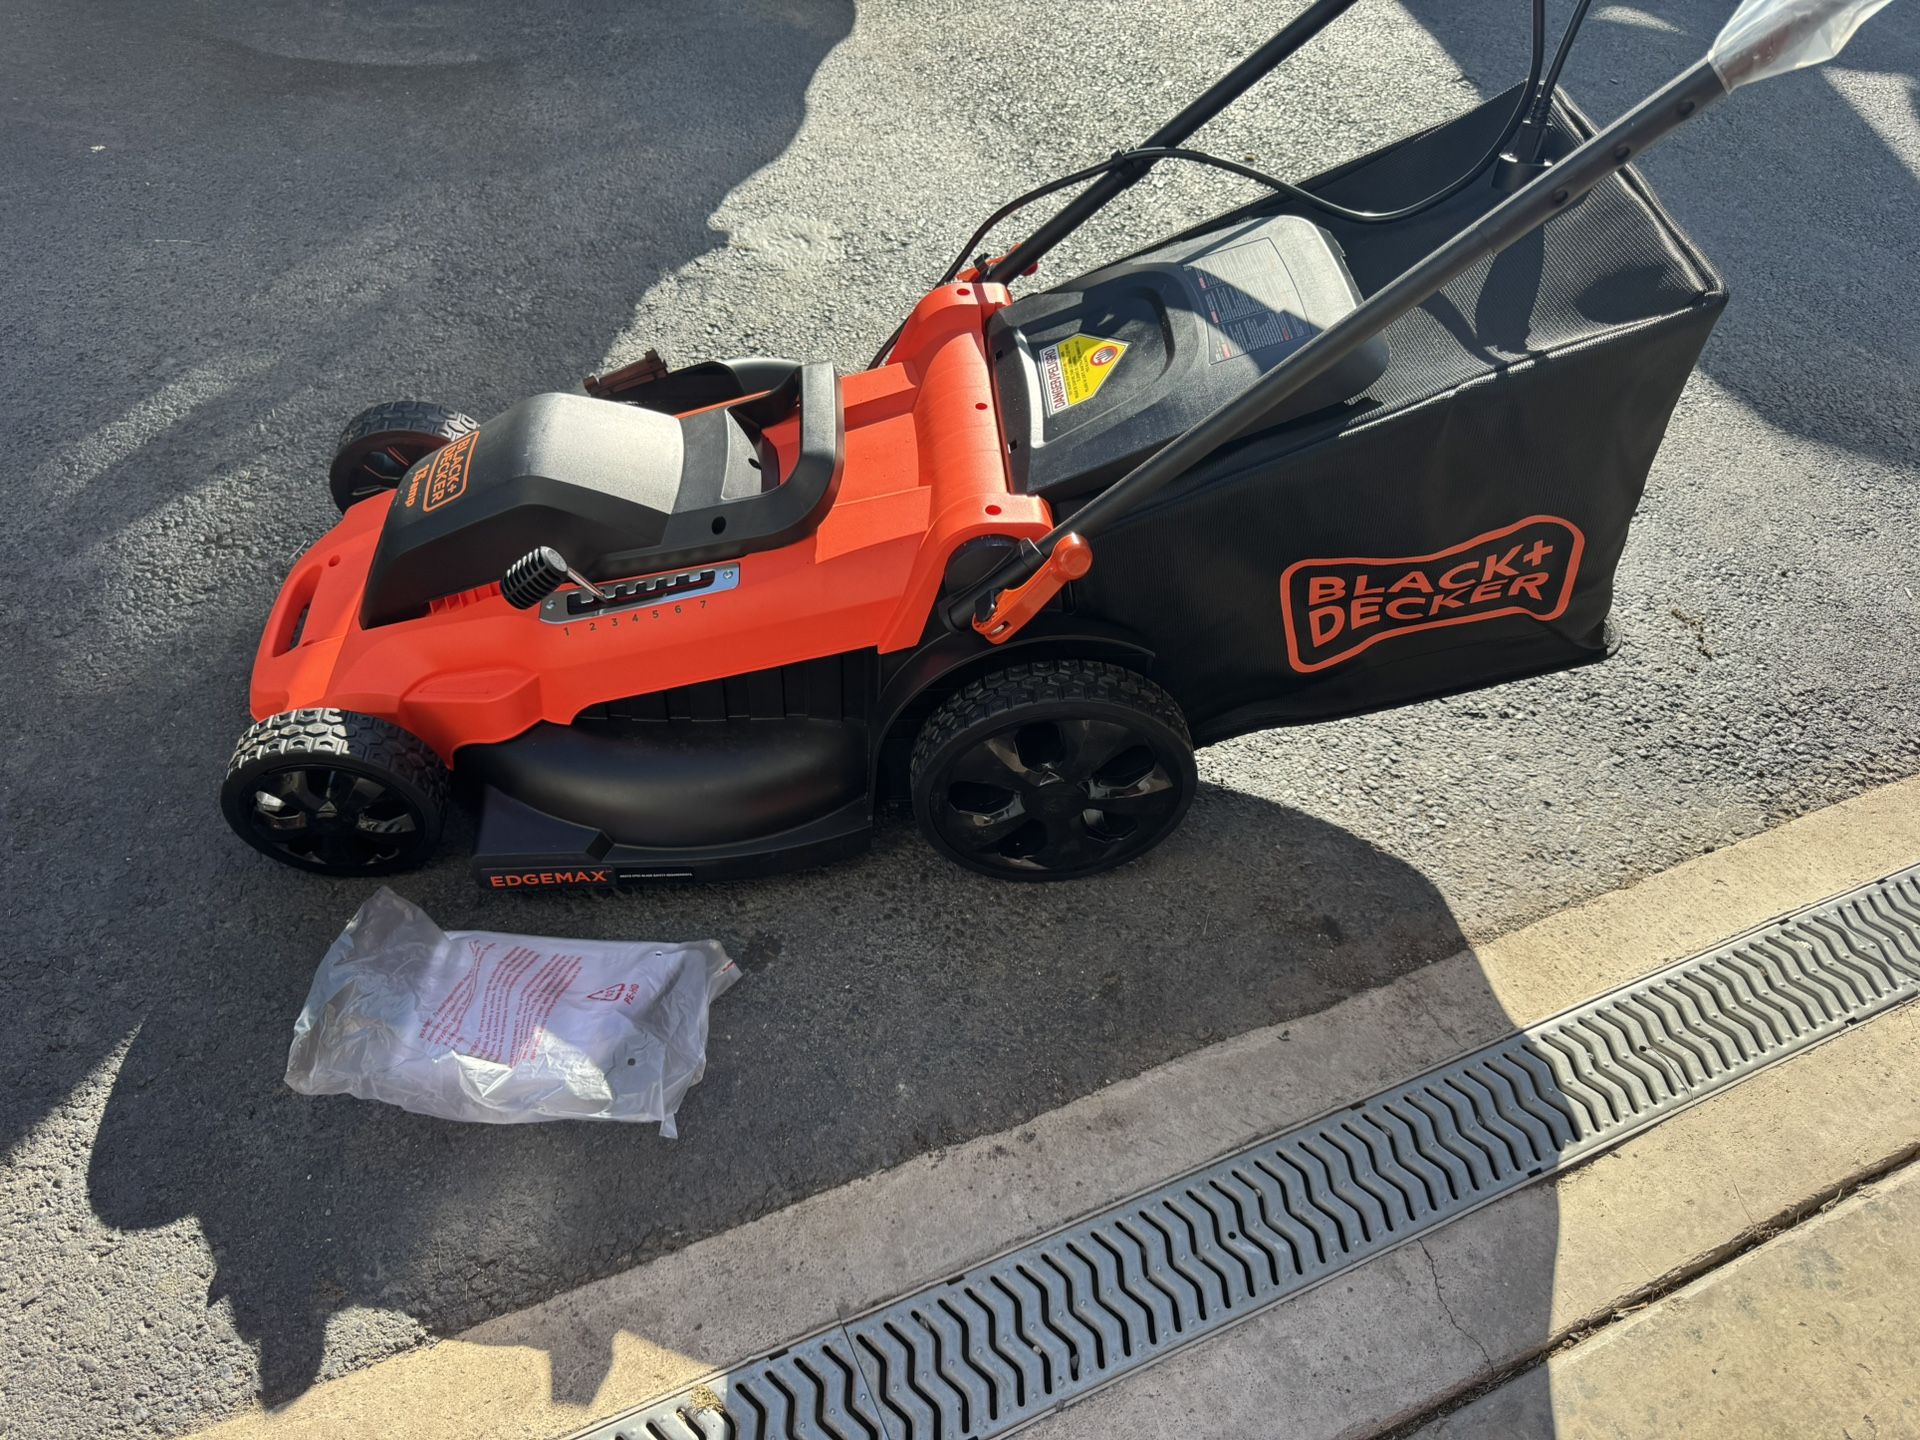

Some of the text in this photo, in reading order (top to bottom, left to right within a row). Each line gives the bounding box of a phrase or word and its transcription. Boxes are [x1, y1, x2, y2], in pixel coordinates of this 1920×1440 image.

[1045, 348, 1066, 409] DANGER/PELIGRO
[431, 445, 457, 503] DECKER
[447, 438, 471, 493] BLACK+
[1308, 540, 1554, 606] BLACK+
[564, 600, 706, 636] 1 2 3 4 5 6 7
[1308, 572, 1549, 648] DECKER
[490, 871, 608, 887] EDGEMAX
